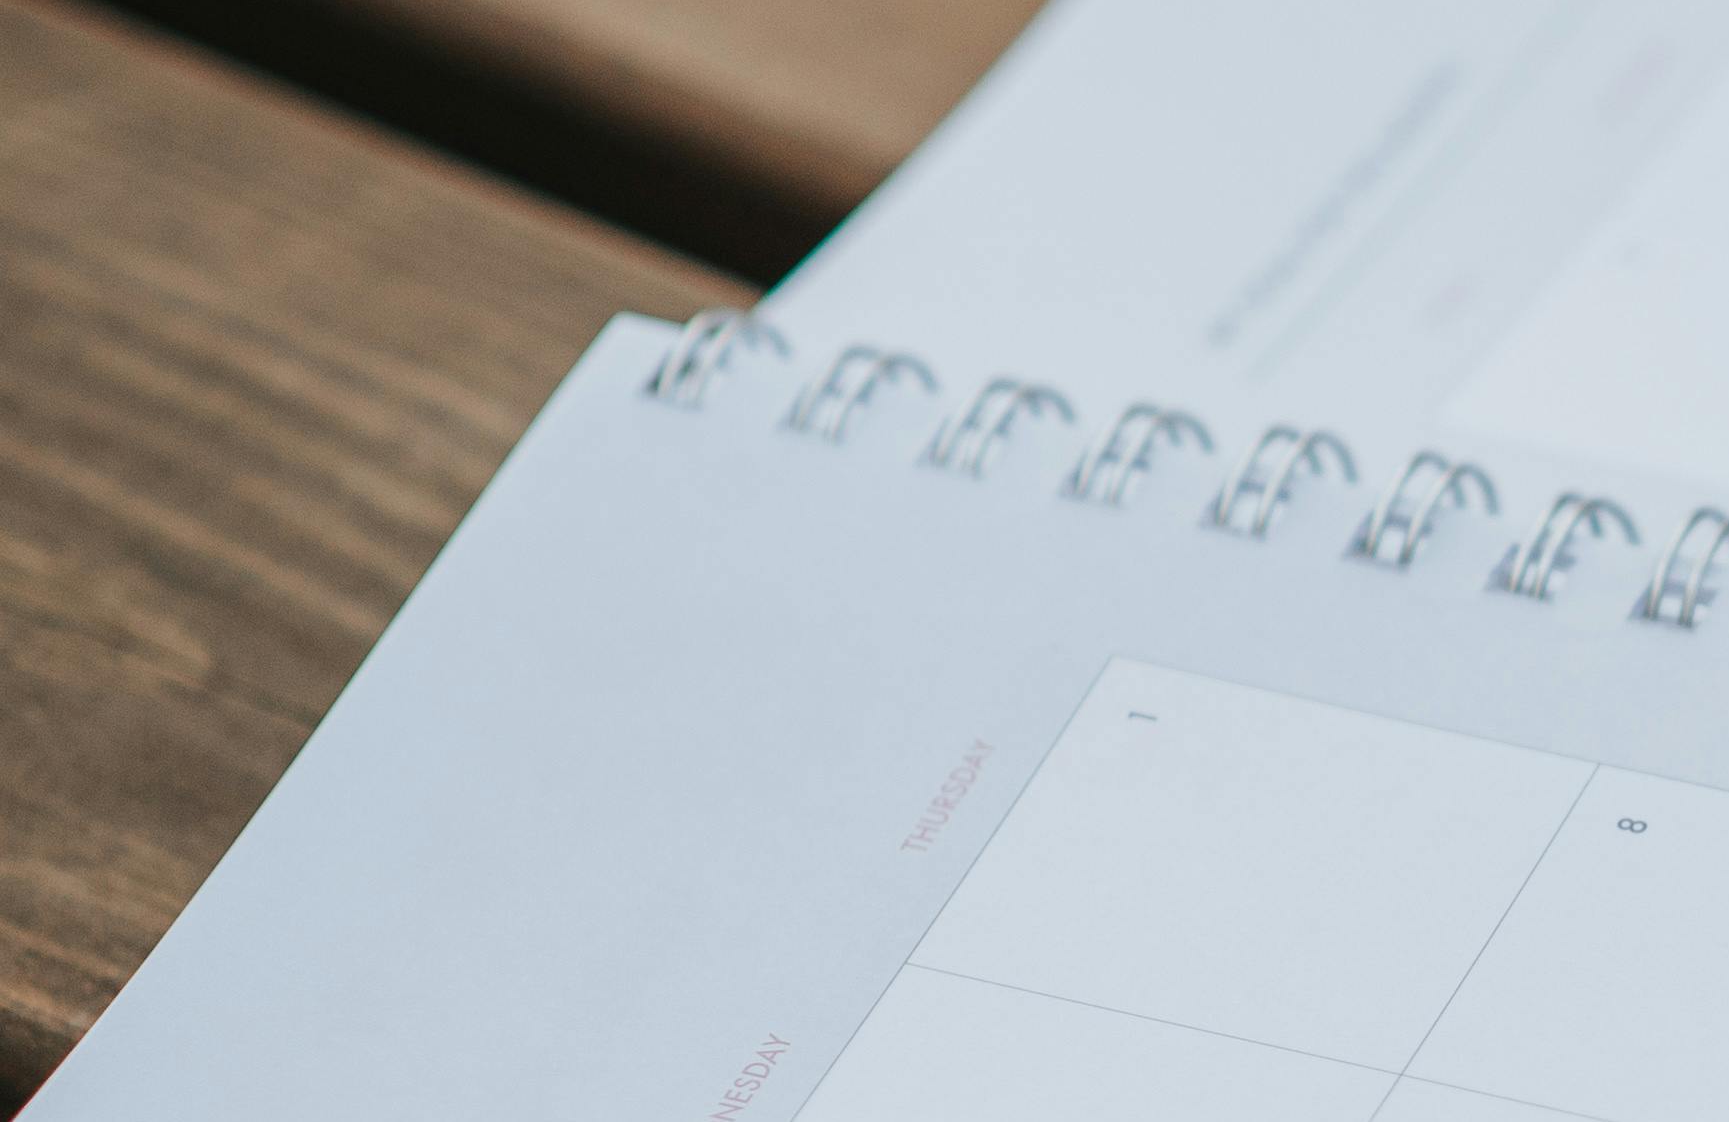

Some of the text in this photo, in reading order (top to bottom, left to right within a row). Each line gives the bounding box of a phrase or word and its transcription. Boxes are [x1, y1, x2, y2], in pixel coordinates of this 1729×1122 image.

[1128, 711, 1158, 721] 1
[899, 736, 994, 851] THURSDAY
[1617, 817, 1648, 834] 8
[704, 1031, 791, 1122] NESDAY
